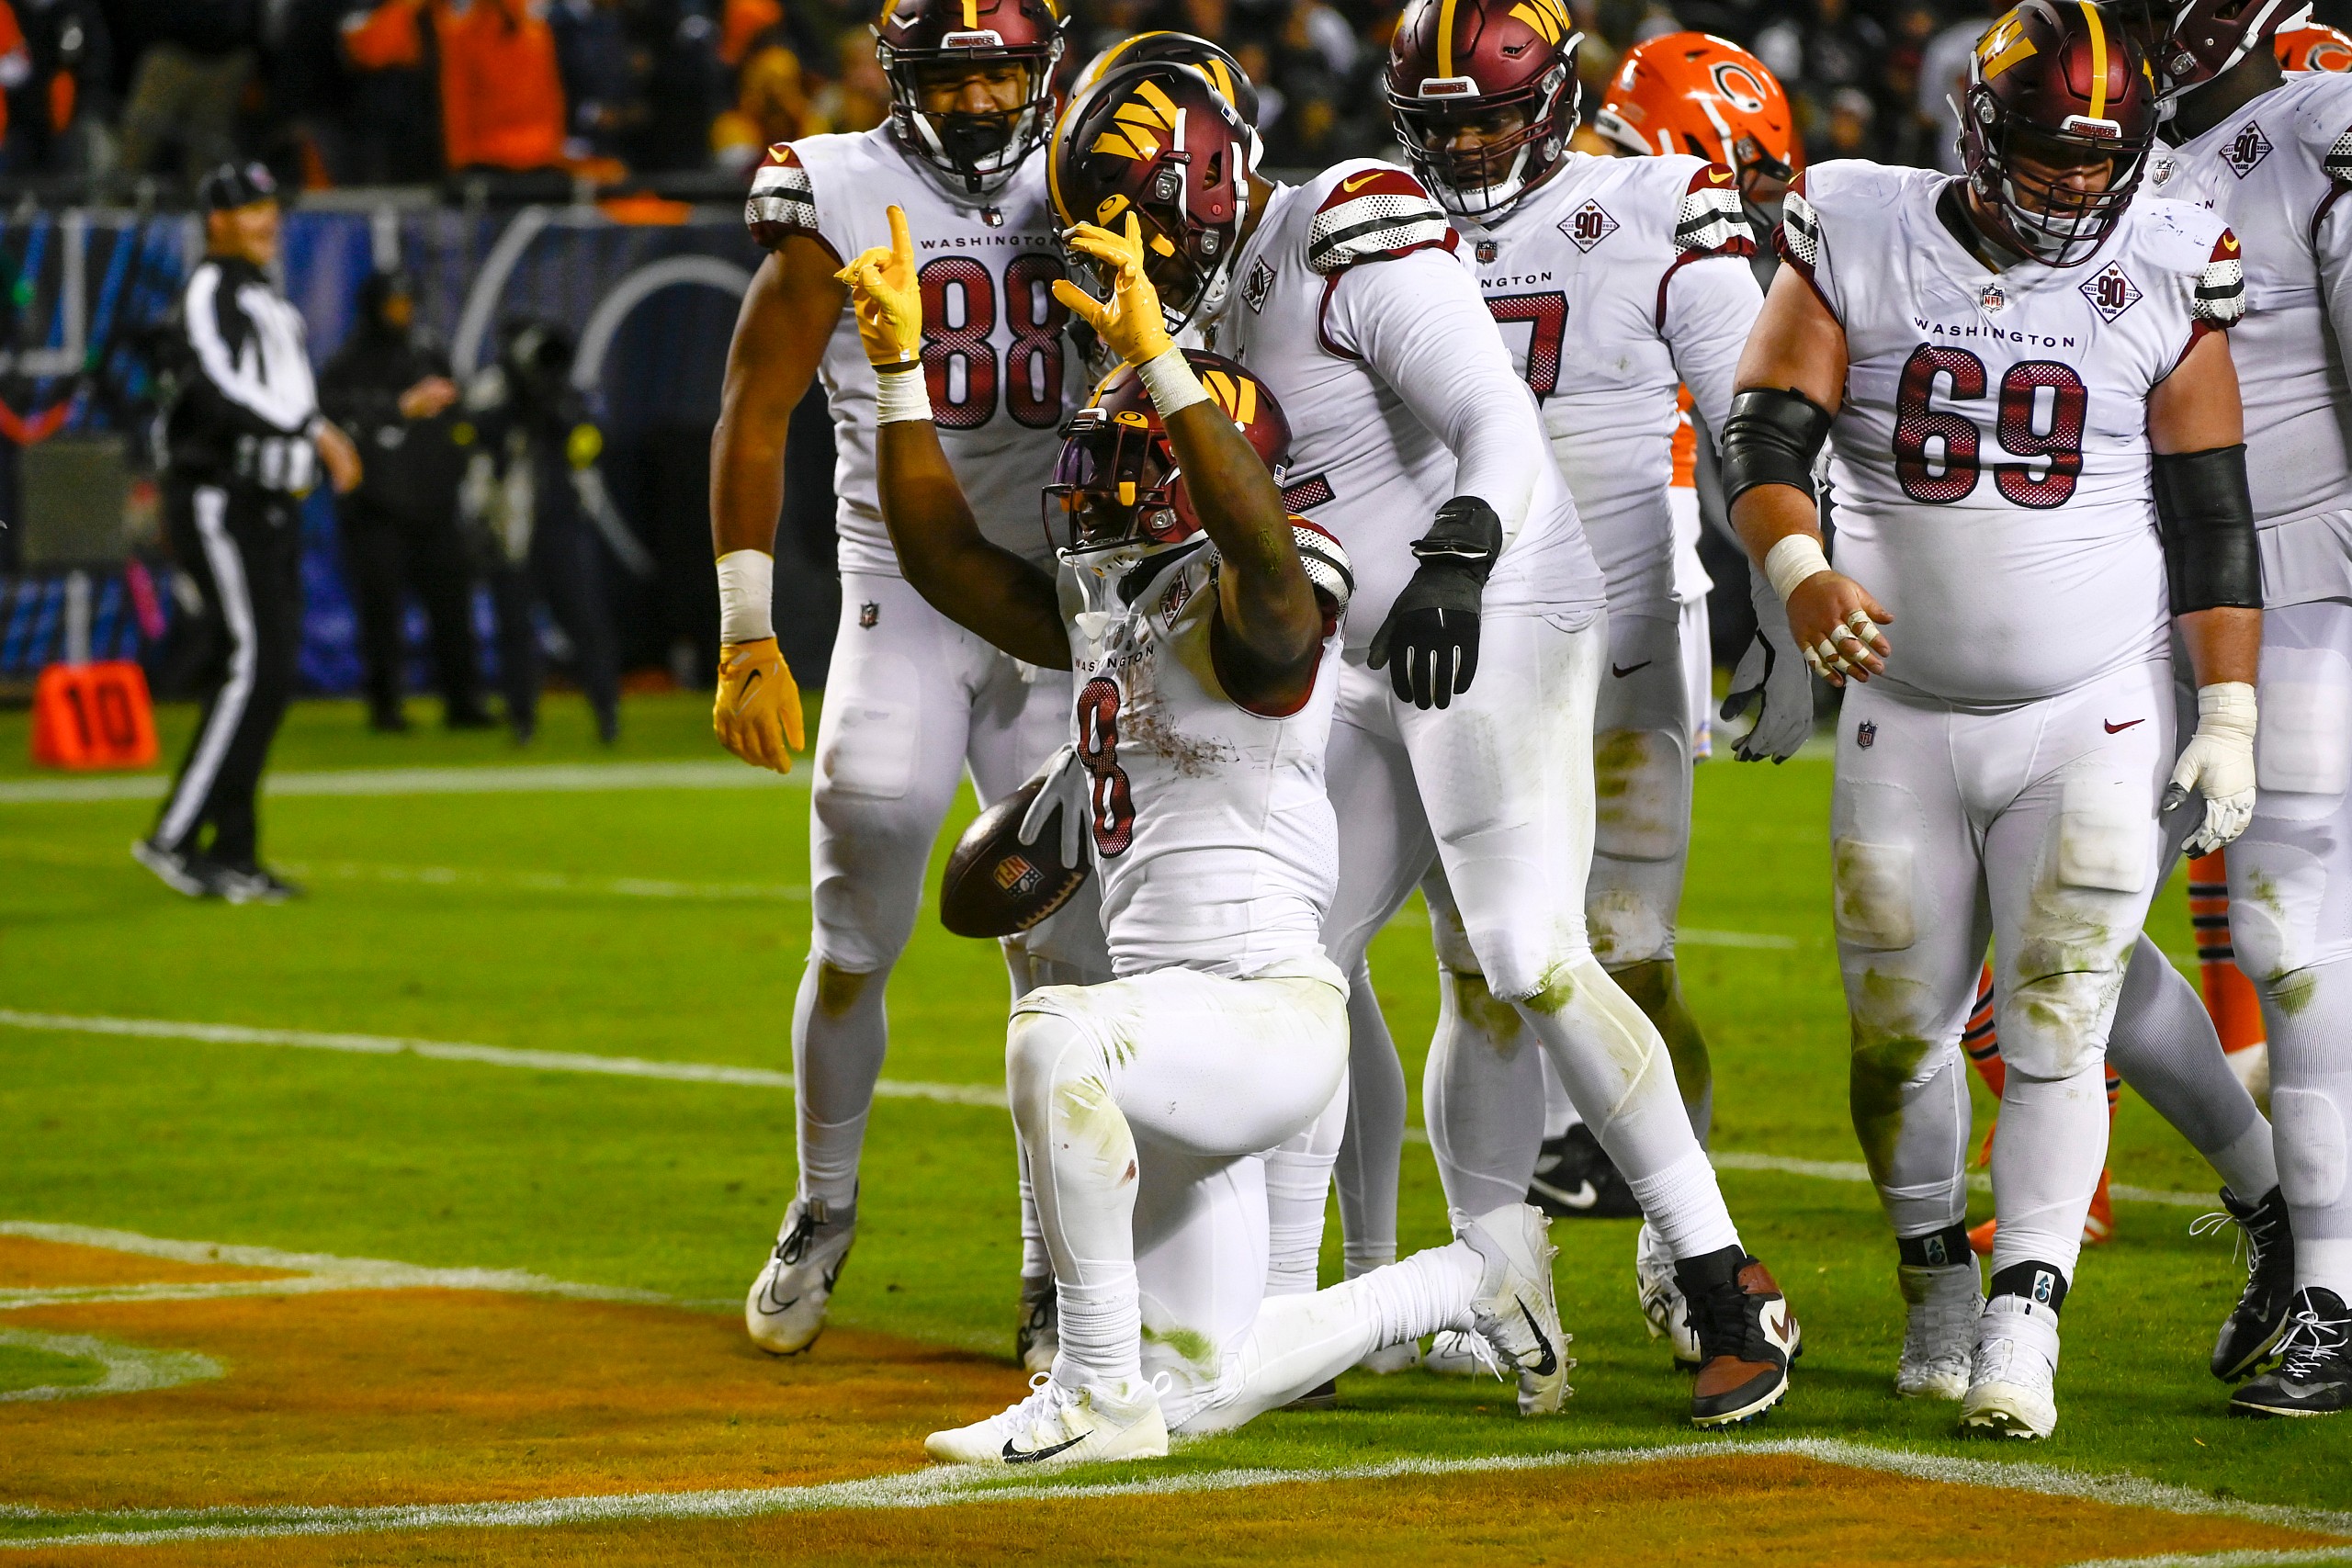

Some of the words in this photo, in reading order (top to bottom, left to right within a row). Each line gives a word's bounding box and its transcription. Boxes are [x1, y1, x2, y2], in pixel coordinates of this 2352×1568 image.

[2232, 134, 2258, 163] 90
[1574, 212, 1603, 239] 90
[1481, 272, 1553, 288] NGTON
[2097, 276, 2126, 309] 90
[918, 253, 1070, 430] 88
[1915, 317, 2075, 347] WASHINGTON
[1484, 289, 1569, 412] 7
[1893, 342, 2088, 509] 69
[1075, 645, 1154, 672] WASNGTON
[66, 682, 137, 748] 10
[1077, 677, 1136, 859] 8
